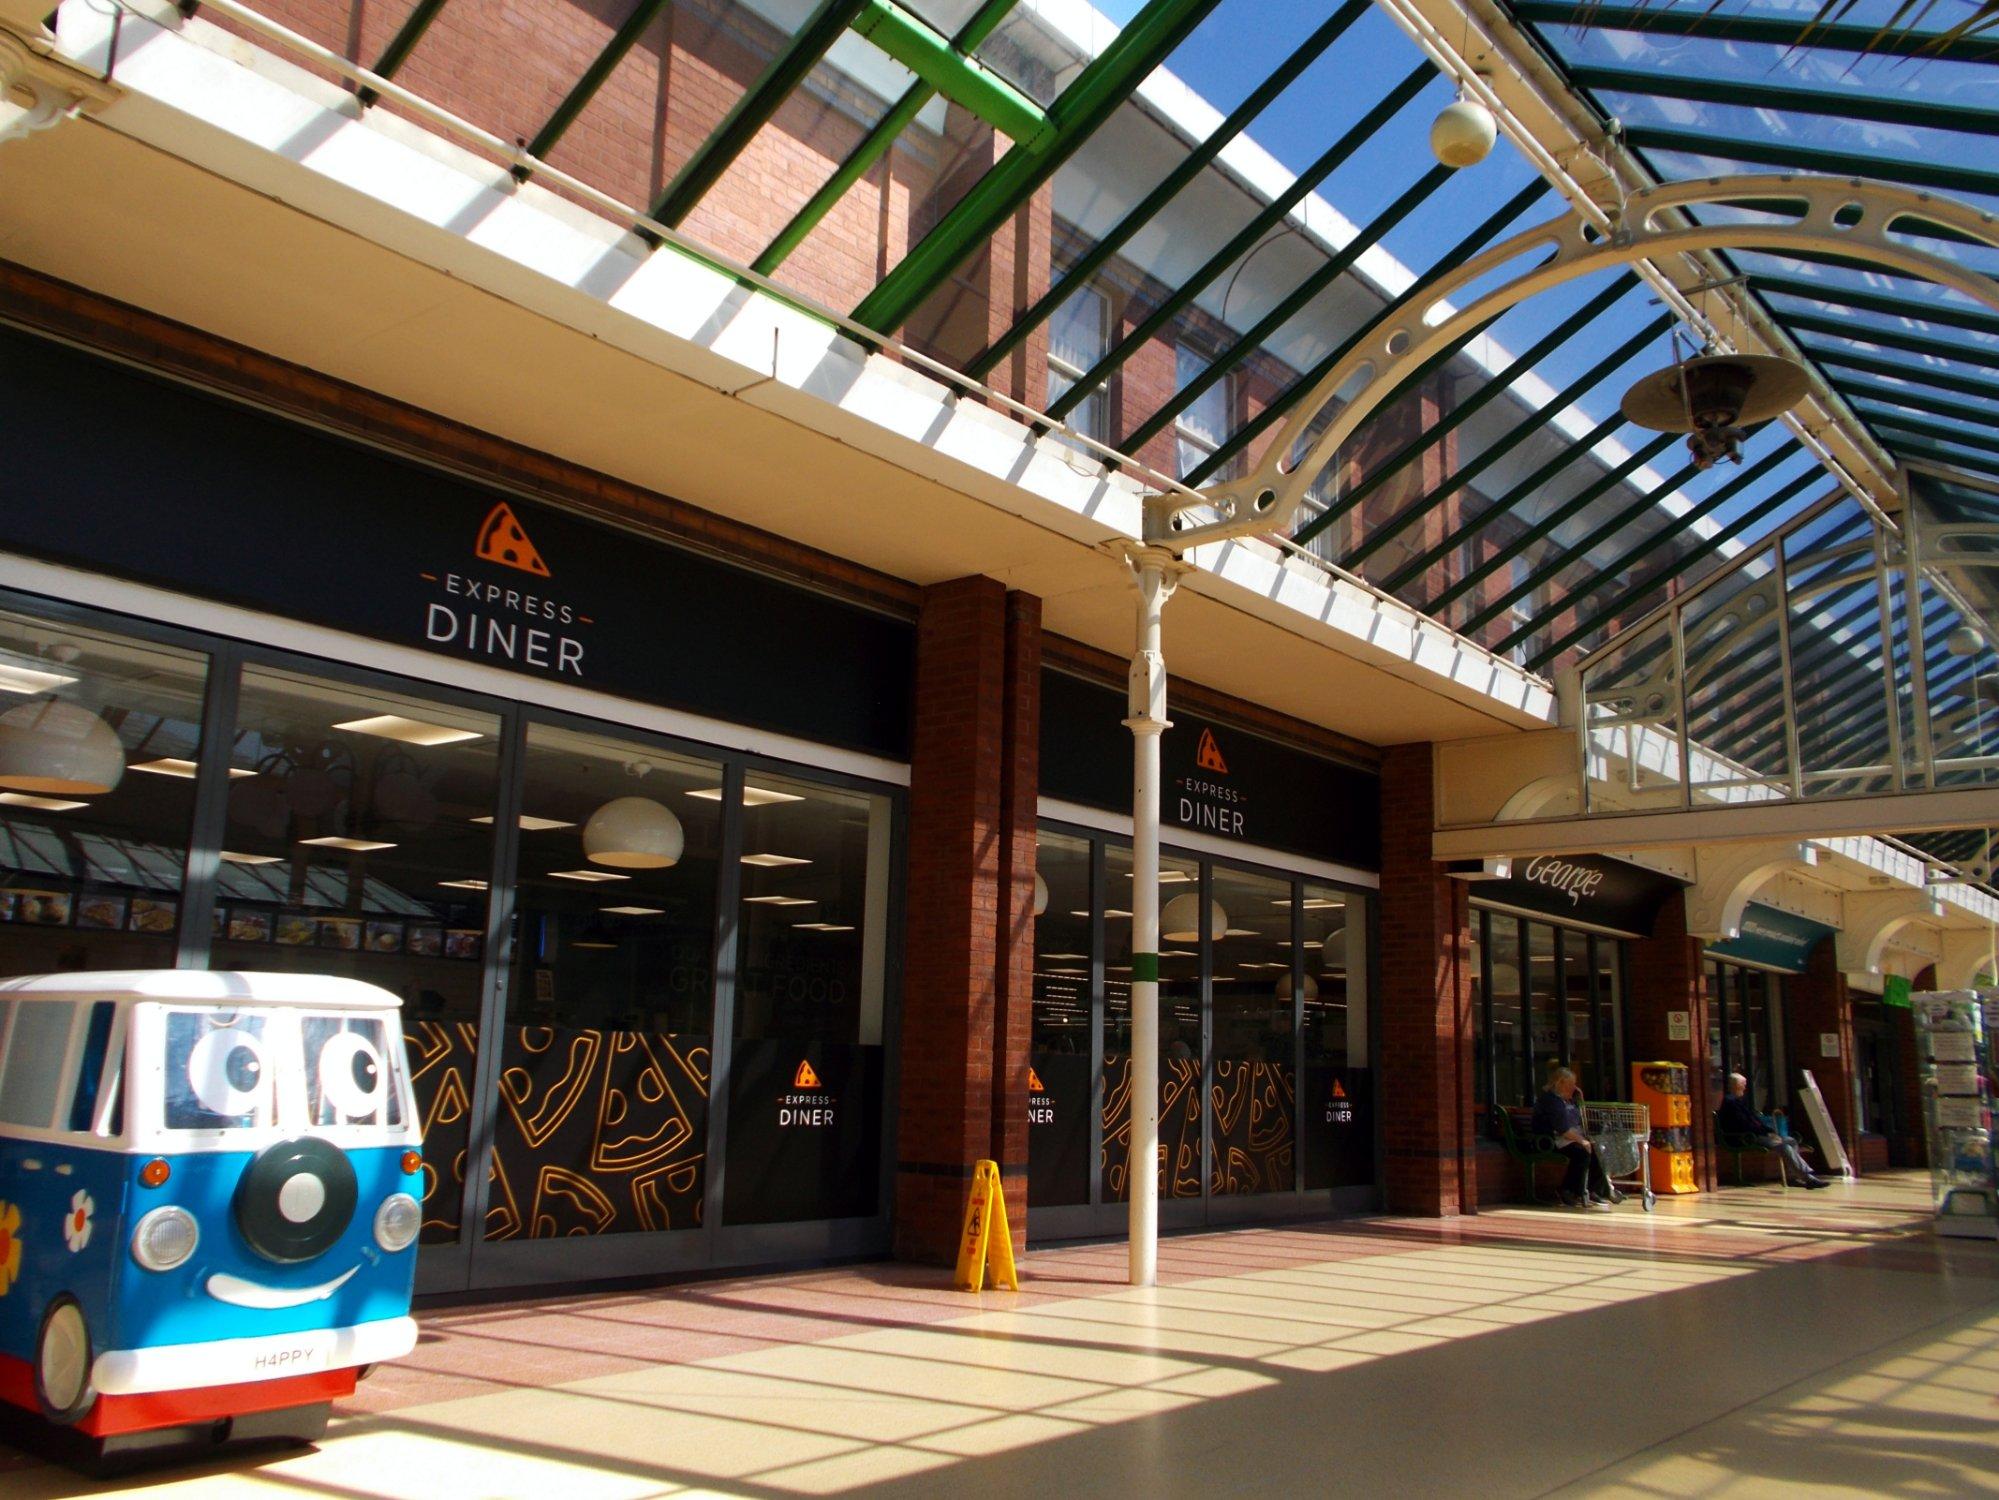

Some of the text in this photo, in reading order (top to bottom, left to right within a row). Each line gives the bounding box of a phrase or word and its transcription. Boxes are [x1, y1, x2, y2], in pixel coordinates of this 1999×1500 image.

[446, 573, 573, 624] EXPRESS
[426, 602, 585, 676] DINER
[1186, 778, 1238, 803] EXPRESS
[1180, 798, 1244, 835] DINER
[785, 1095, 830, 1105] EXPRESS
[780, 1109, 834, 1126] DINER
[1028, 1109, 1054, 1123] NER
[1326, 1110, 1352, 1122] DINER
[255, 1347, 314, 1368] H4PPY
